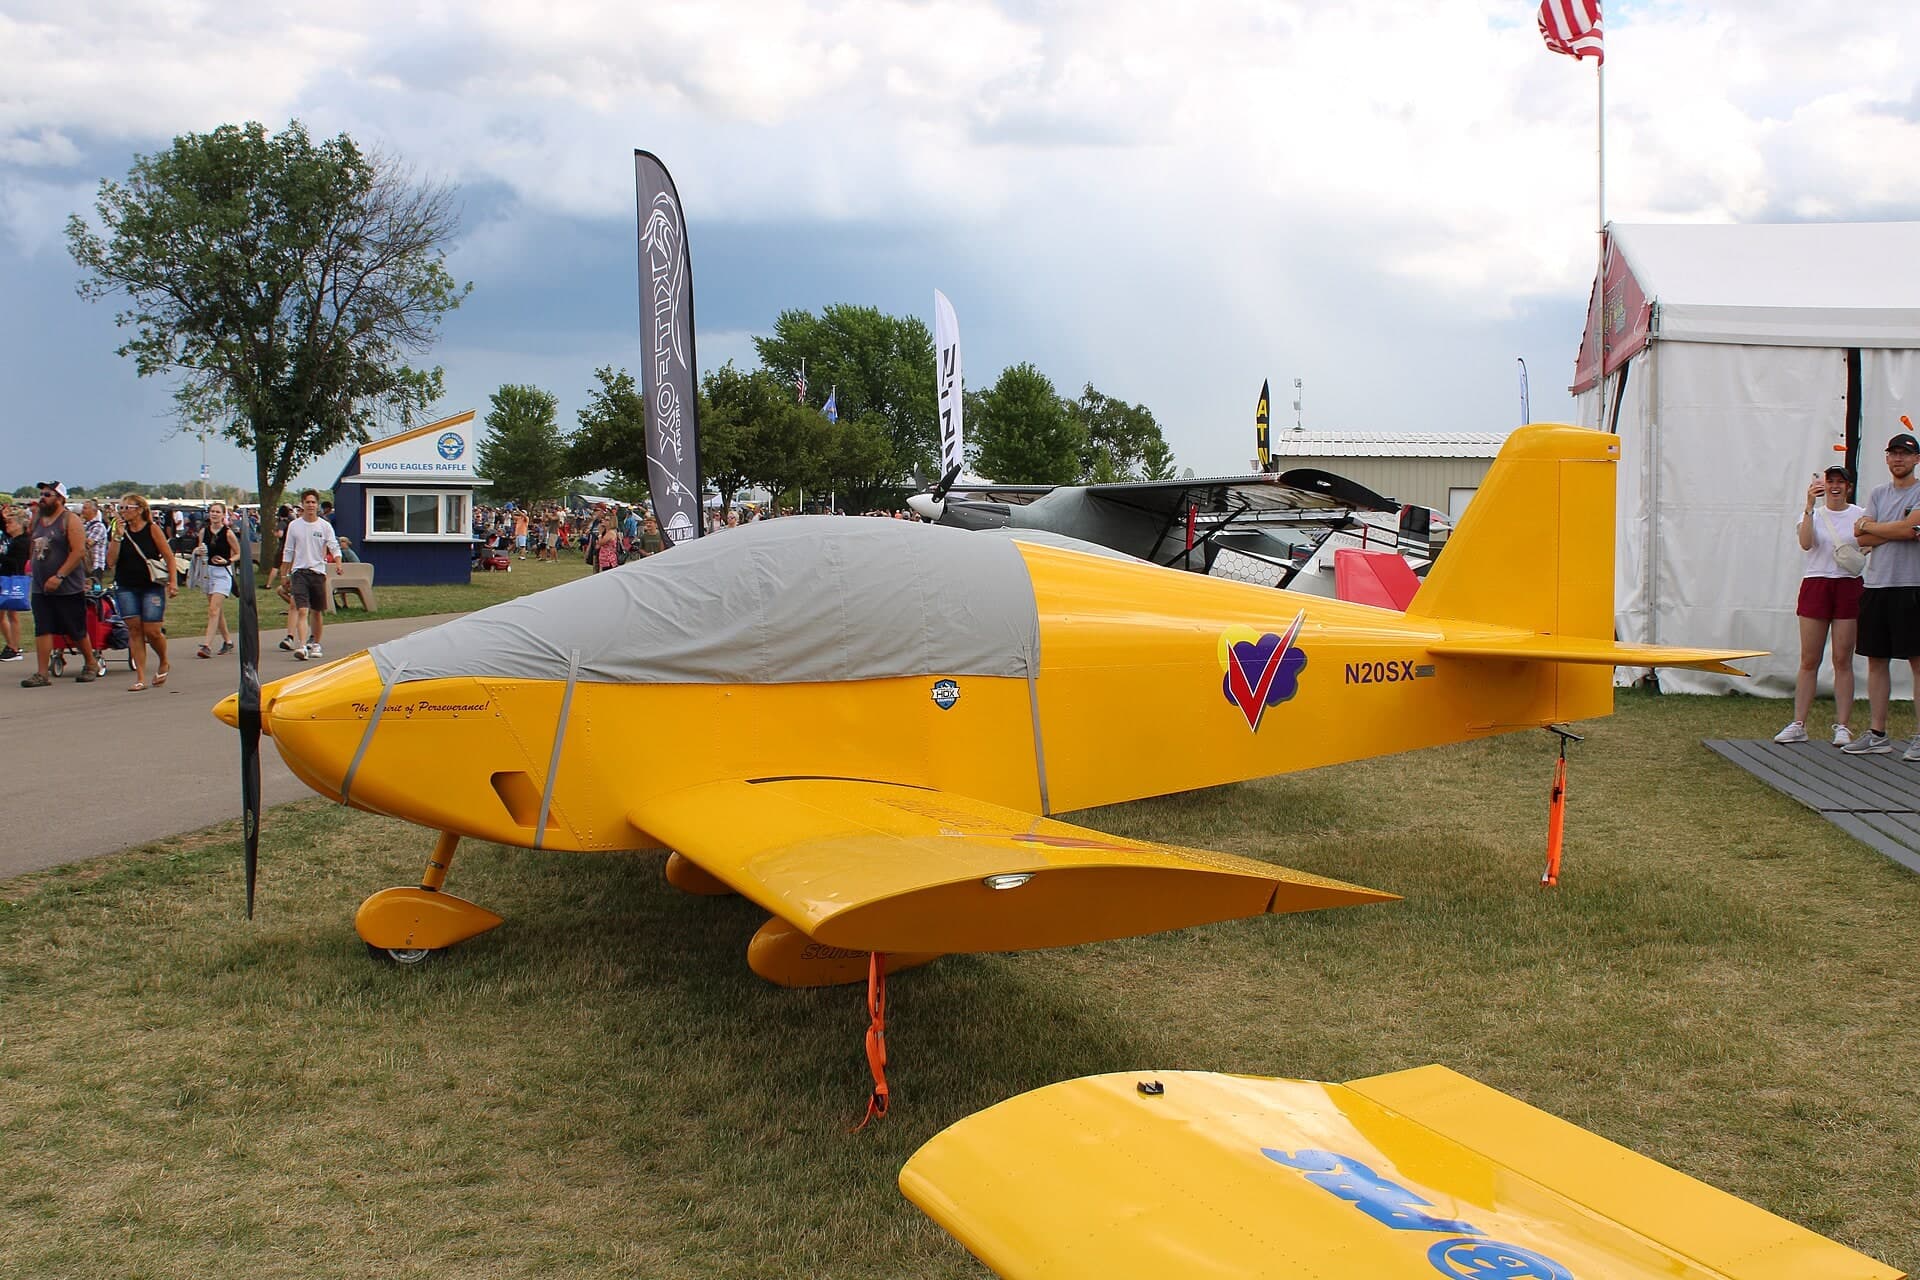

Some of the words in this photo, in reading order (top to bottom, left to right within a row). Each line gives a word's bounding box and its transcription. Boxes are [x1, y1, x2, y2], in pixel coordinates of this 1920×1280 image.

[366, 462, 398, 470] YOUNG
[435, 463, 467, 471] RAFFLE
[1345, 660, 1415, 684] N20SX
[352, 703, 369, 713] The
[405, 704, 415, 714] of
[418, 701, 490, 712] Perseverance!
